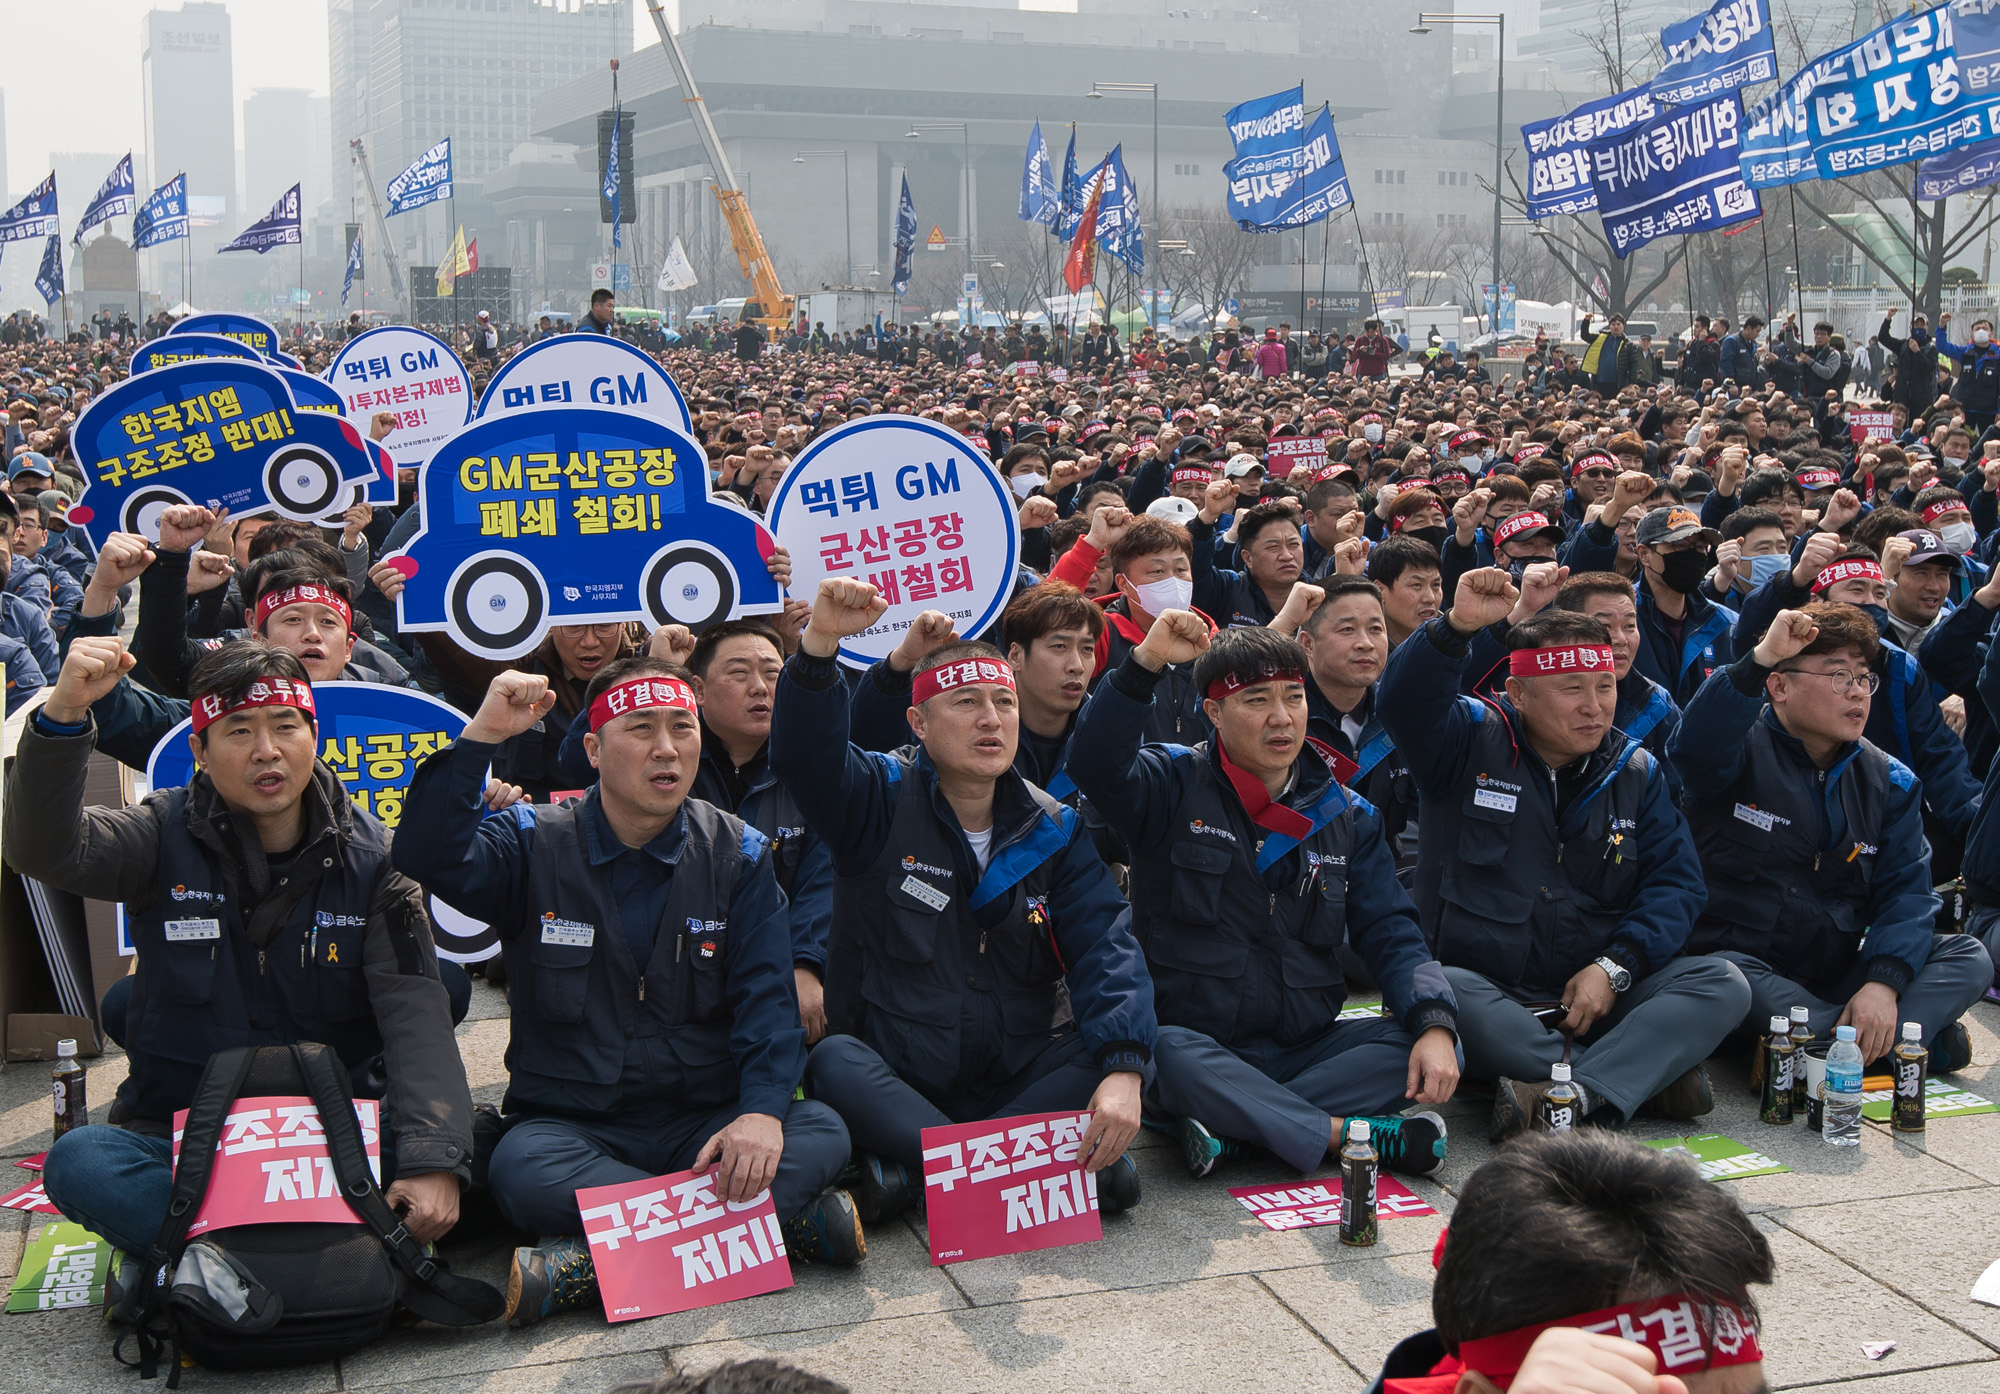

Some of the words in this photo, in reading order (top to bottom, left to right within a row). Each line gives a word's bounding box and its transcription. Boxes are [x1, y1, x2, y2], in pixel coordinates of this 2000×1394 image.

[1340, 298, 1360, 308] 주차장
[345, 356, 392, 384] 먹튀
[400, 348, 440, 372] GM
[590, 372, 648, 406] GM
[119, 386, 243, 446] 한국지엠
[1850, 414, 1894, 426] 구조조정
[1867, 427, 1893, 439] 저지!
[96, 434, 216, 488] 구조조정
[220, 408, 296, 453] 반대!
[1268, 438, 1326, 456] 구조조정
[460, 447, 677, 492] GM군산공장
[1578, 456, 1596, 468] 단결
[298, 477, 310, 486] GM
[1176, 470, 1191, 480] 단결
[222, 488, 252, 500] 한국지엠지부
[800, 472, 879, 518] 먹튀
[896, 458, 961, 501] GM
[480, 500, 558, 538] 폐쇄
[572, 493, 662, 534] 철회!
[1500, 520, 1522, 538] 단결
[820, 512, 964, 572] 군산공장
[1919, 534, 1938, 550] D
[851, 556, 974, 606] 쇄철회
[1818, 562, 1848, 586] 단결
[584, 583, 624, 593] 한국지엠지부
[591, 590, 618, 601] 사무지회
[682, 588, 698, 596] GM
[266, 586, 297, 610] 단결
[322, 590, 348, 616] 투쟁
[490, 598, 506, 608] GM
[1536, 650, 1576, 672] 단결
[936, 661, 977, 689] 단결
[274, 678, 313, 708] 투쟁
[607, 682, 653, 716] 단결
[1488, 778, 1522, 793] 한국지엠지부
[1204, 825, 1236, 842] 한국지엠지부
[916, 862, 953, 878] 한국지엠지부
[1321, 855, 1346, 866] 속노조
[701, 948, 714, 958] Too
[1898, 1063, 1920, 1098] 男
[923, 1113, 1097, 1193] 구조조정
[1000, 1169, 1098, 1235] 저지!
[1236, 1184, 1341, 1211] 저지!
[1258, 1194, 1431, 1231] 구조정
[671, 1211, 786, 1290] 저지!
